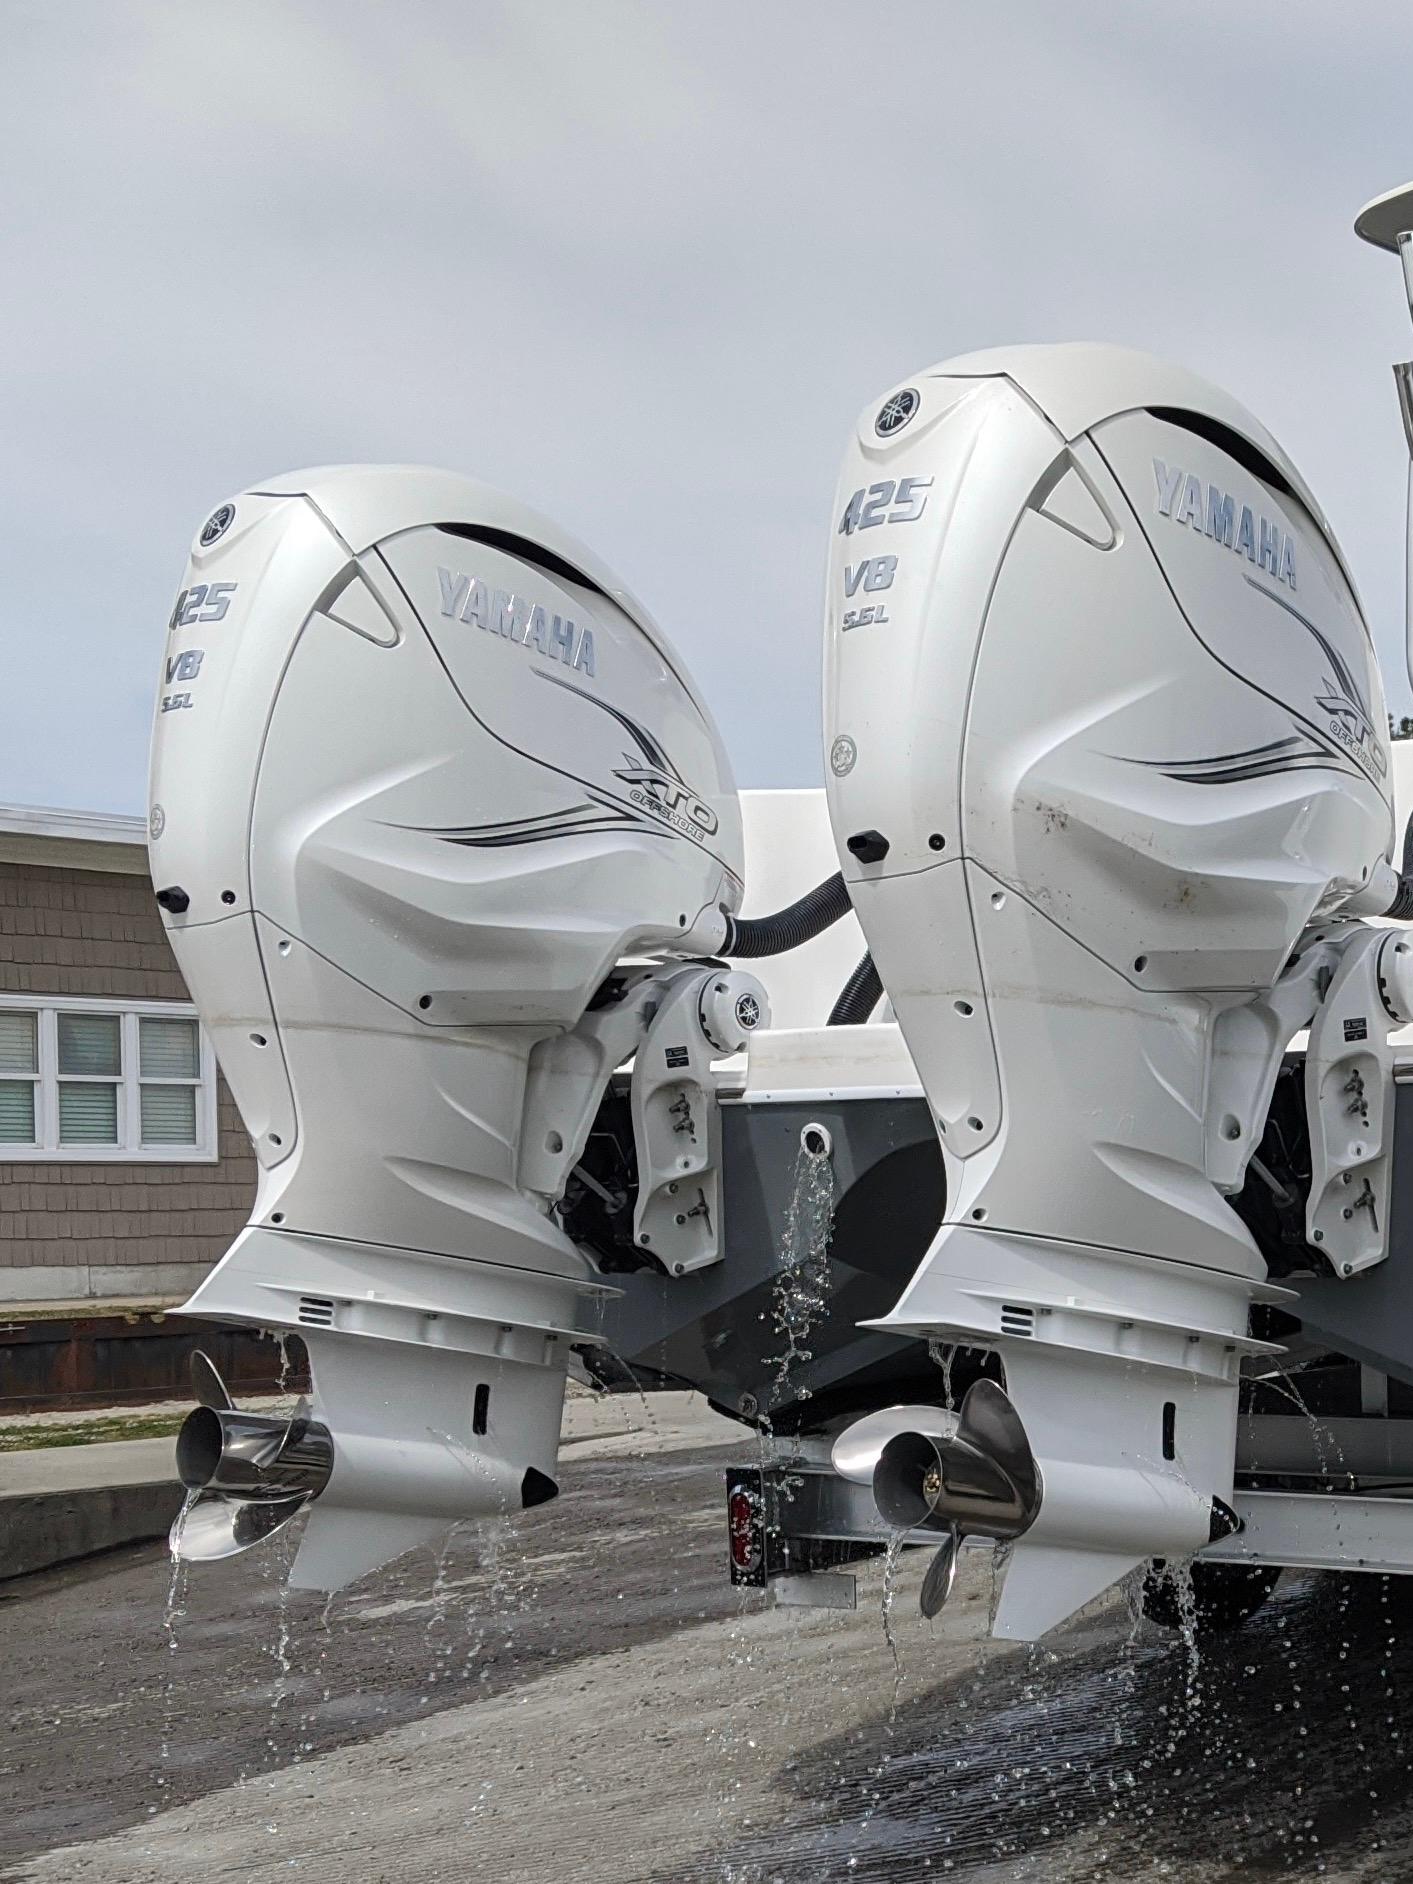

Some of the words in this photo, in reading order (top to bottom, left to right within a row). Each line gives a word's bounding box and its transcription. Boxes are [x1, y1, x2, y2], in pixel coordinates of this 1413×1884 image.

[838, 476, 934, 535] 425
[1153, 457, 1296, 591] YAMAHA
[845, 555, 898, 598] V8
[437, 566, 594, 677] YAMAHA
[842, 605, 889, 632] 5.6L
[165, 650, 205, 684] V8
[1314, 676, 1387, 778] XTO
[611, 752, 718, 836] XTO
[629, 789, 706, 842] OFFSHORE
